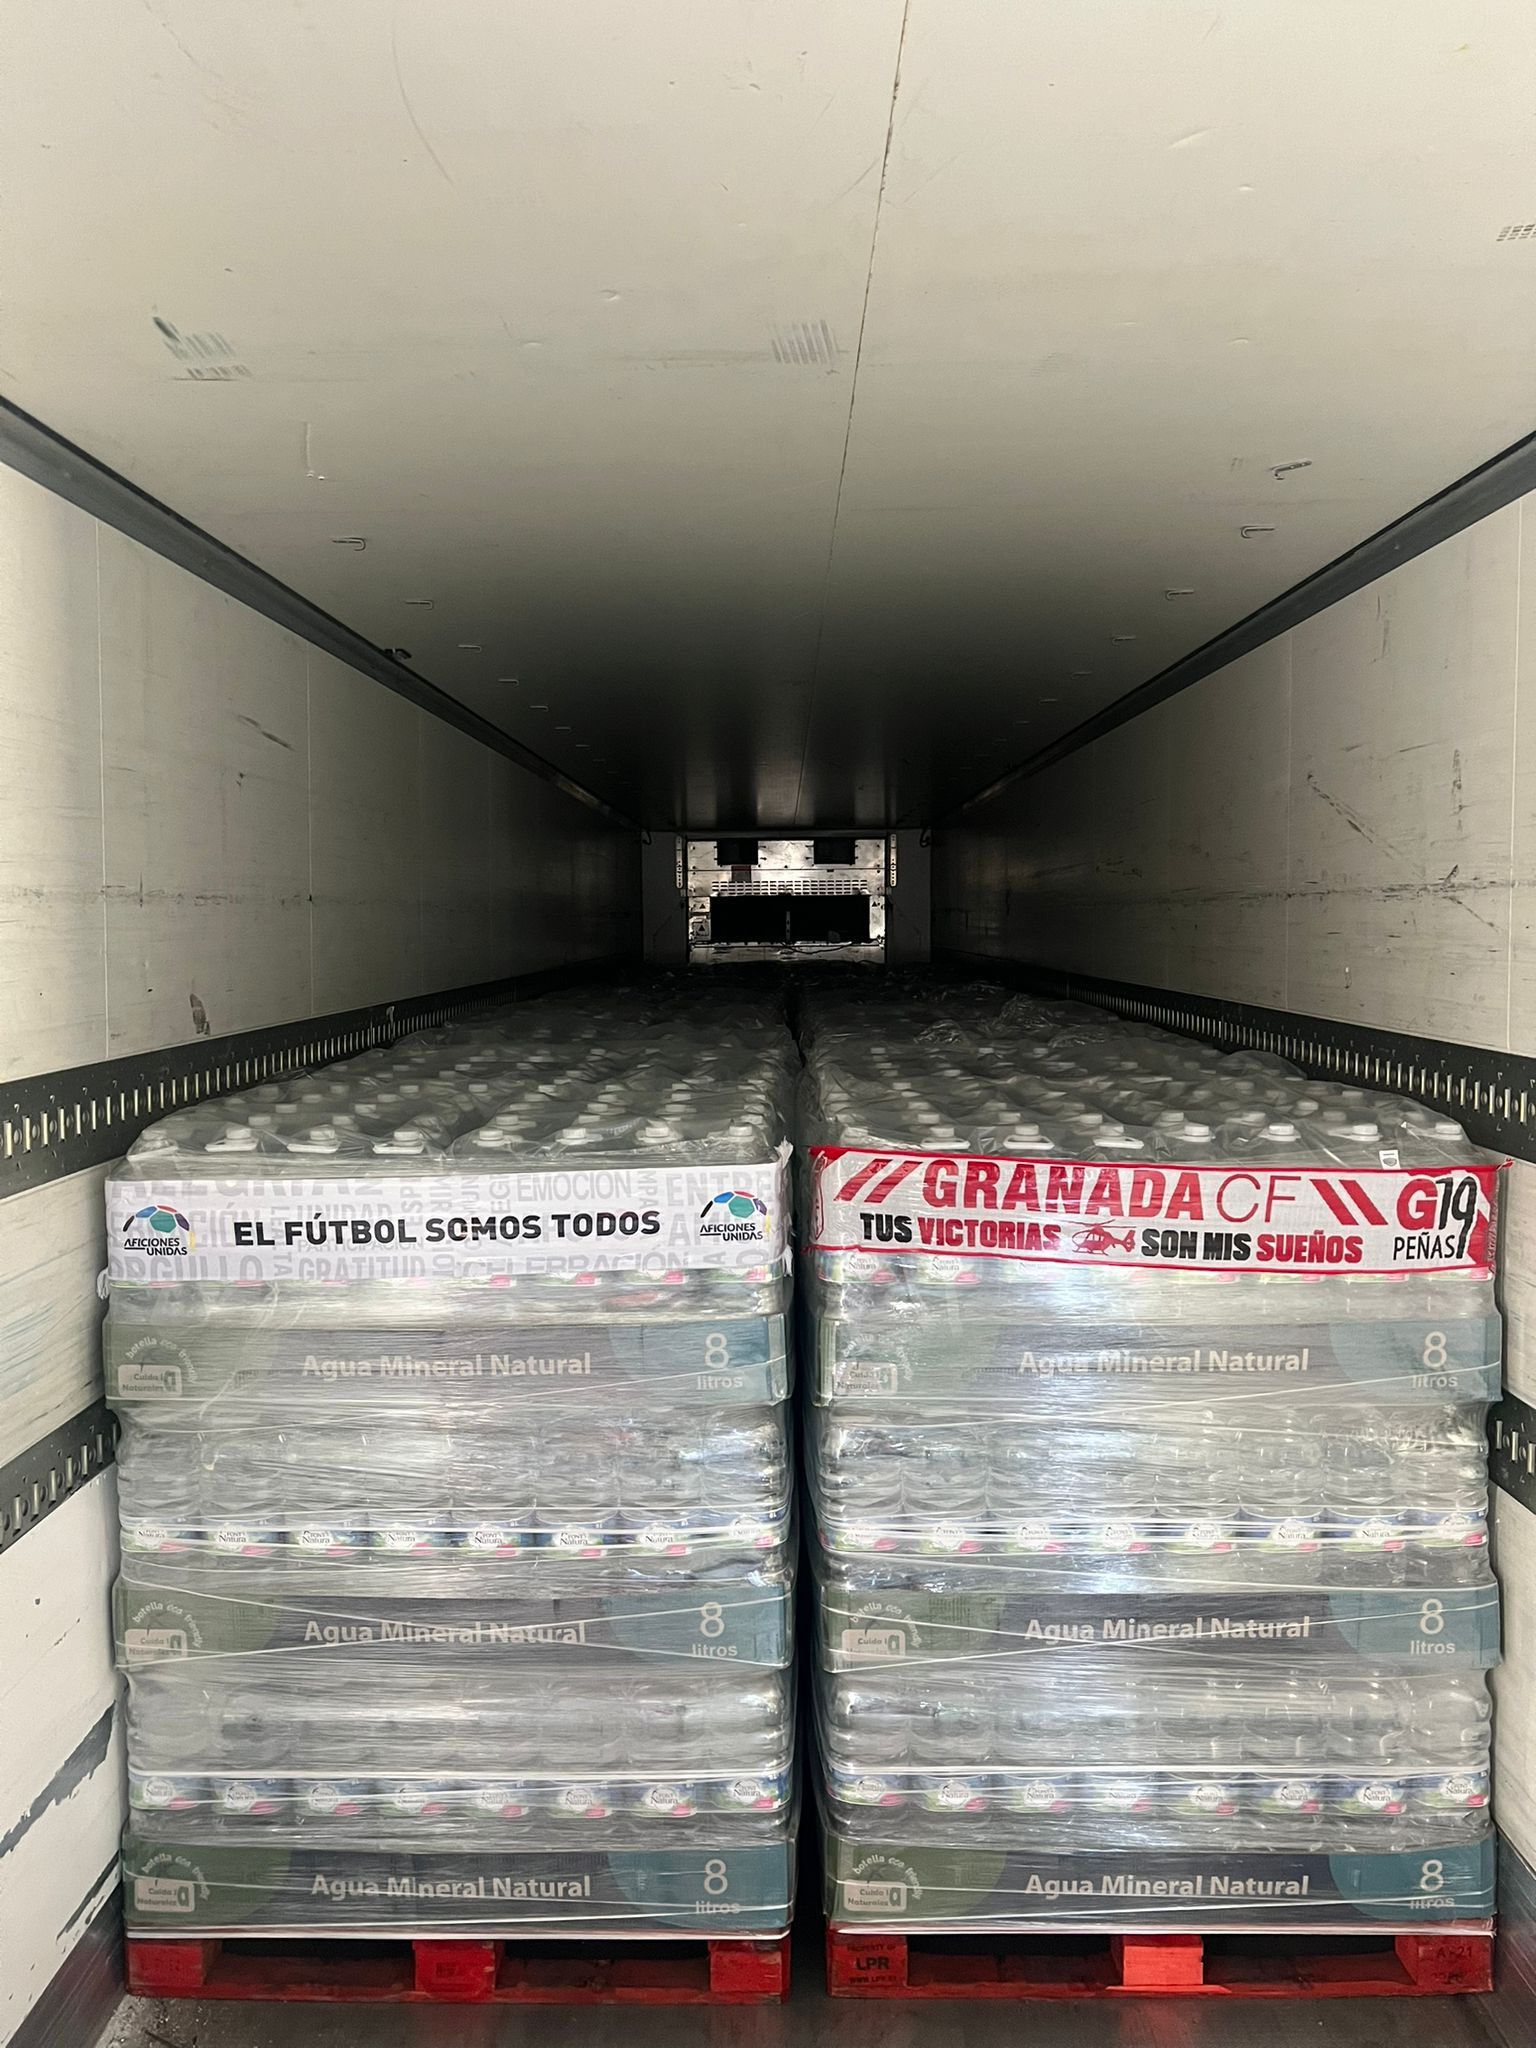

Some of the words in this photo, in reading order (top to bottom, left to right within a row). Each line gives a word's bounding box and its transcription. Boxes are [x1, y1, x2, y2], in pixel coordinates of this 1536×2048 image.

[922, 1159, 1204, 1221] GRANADA
[1216, 1173, 1302, 1223] CF
[234, 1222, 275, 1246] EL
[285, 1212, 417, 1246] FÚTBOL
[426, 1215, 542, 1242] SOMOS
[551, 1211, 661, 1238] TODOS
[700, 1222, 756, 1233] AFICIONES
[722, 1231, 763, 1242] UNIDAS
[860, 1213, 912, 1243] TUS
[917, 1216, 1062, 1250] VICTORIAS
[1142, 1228, 1198, 1260] SON
[1202, 1231, 1251, 1261] MIS
[1256, 1229, 1363, 1264] SUEÑOS
[124, 1237, 180, 1248] AFICIONES
[147, 1247, 188, 1256] UNIDAS
[1393, 1231, 1456, 1261] PEÑAS
[705, 1333, 729, 1369] 8
[1019, 1351, 1090, 1377] Agua
[1097, 1350, 1200, 1372] Mineral
[1208, 1348, 1309, 1372] Natural
[1422, 1331, 1447, 1368] 8
[302, 1355, 372, 1381] Agua
[380, 1354, 482, 1377] Mineral
[490, 1352, 591, 1377] Natural
[696, 1374, 743, 1390] litros
[132, 1601, 163, 1623] botella
[699, 1602, 725, 1638] 8
[1419, 1598, 1444, 1635] 8
[304, 1620, 373, 1646] Agua
[381, 1621, 482, 1643] Mineral
[490, 1621, 586, 1643] Natural
[1024, 1619, 1094, 1645] Agua
[1102, 1618, 1203, 1640] Mineral
[1211, 1616, 1310, 1639] Natural
[691, 1643, 738, 1657] litros
[1410, 1640, 1456, 1655] litros
[704, 1859, 728, 1895] 8
[852, 1854, 885, 1874] botella
[1420, 1859, 1444, 1892] 8
[312, 1874, 379, 1900] Agua
[387, 1877, 484, 1898] Mineral
[493, 1876, 591, 1897] Natural
[1025, 1874, 1094, 1899] Agua
[1102, 1874, 1203, 1896] Mineral
[1210, 1875, 1309, 1896] Natural
[696, 1900, 741, 1914] litros
[856, 1956, 889, 1970] LPR
